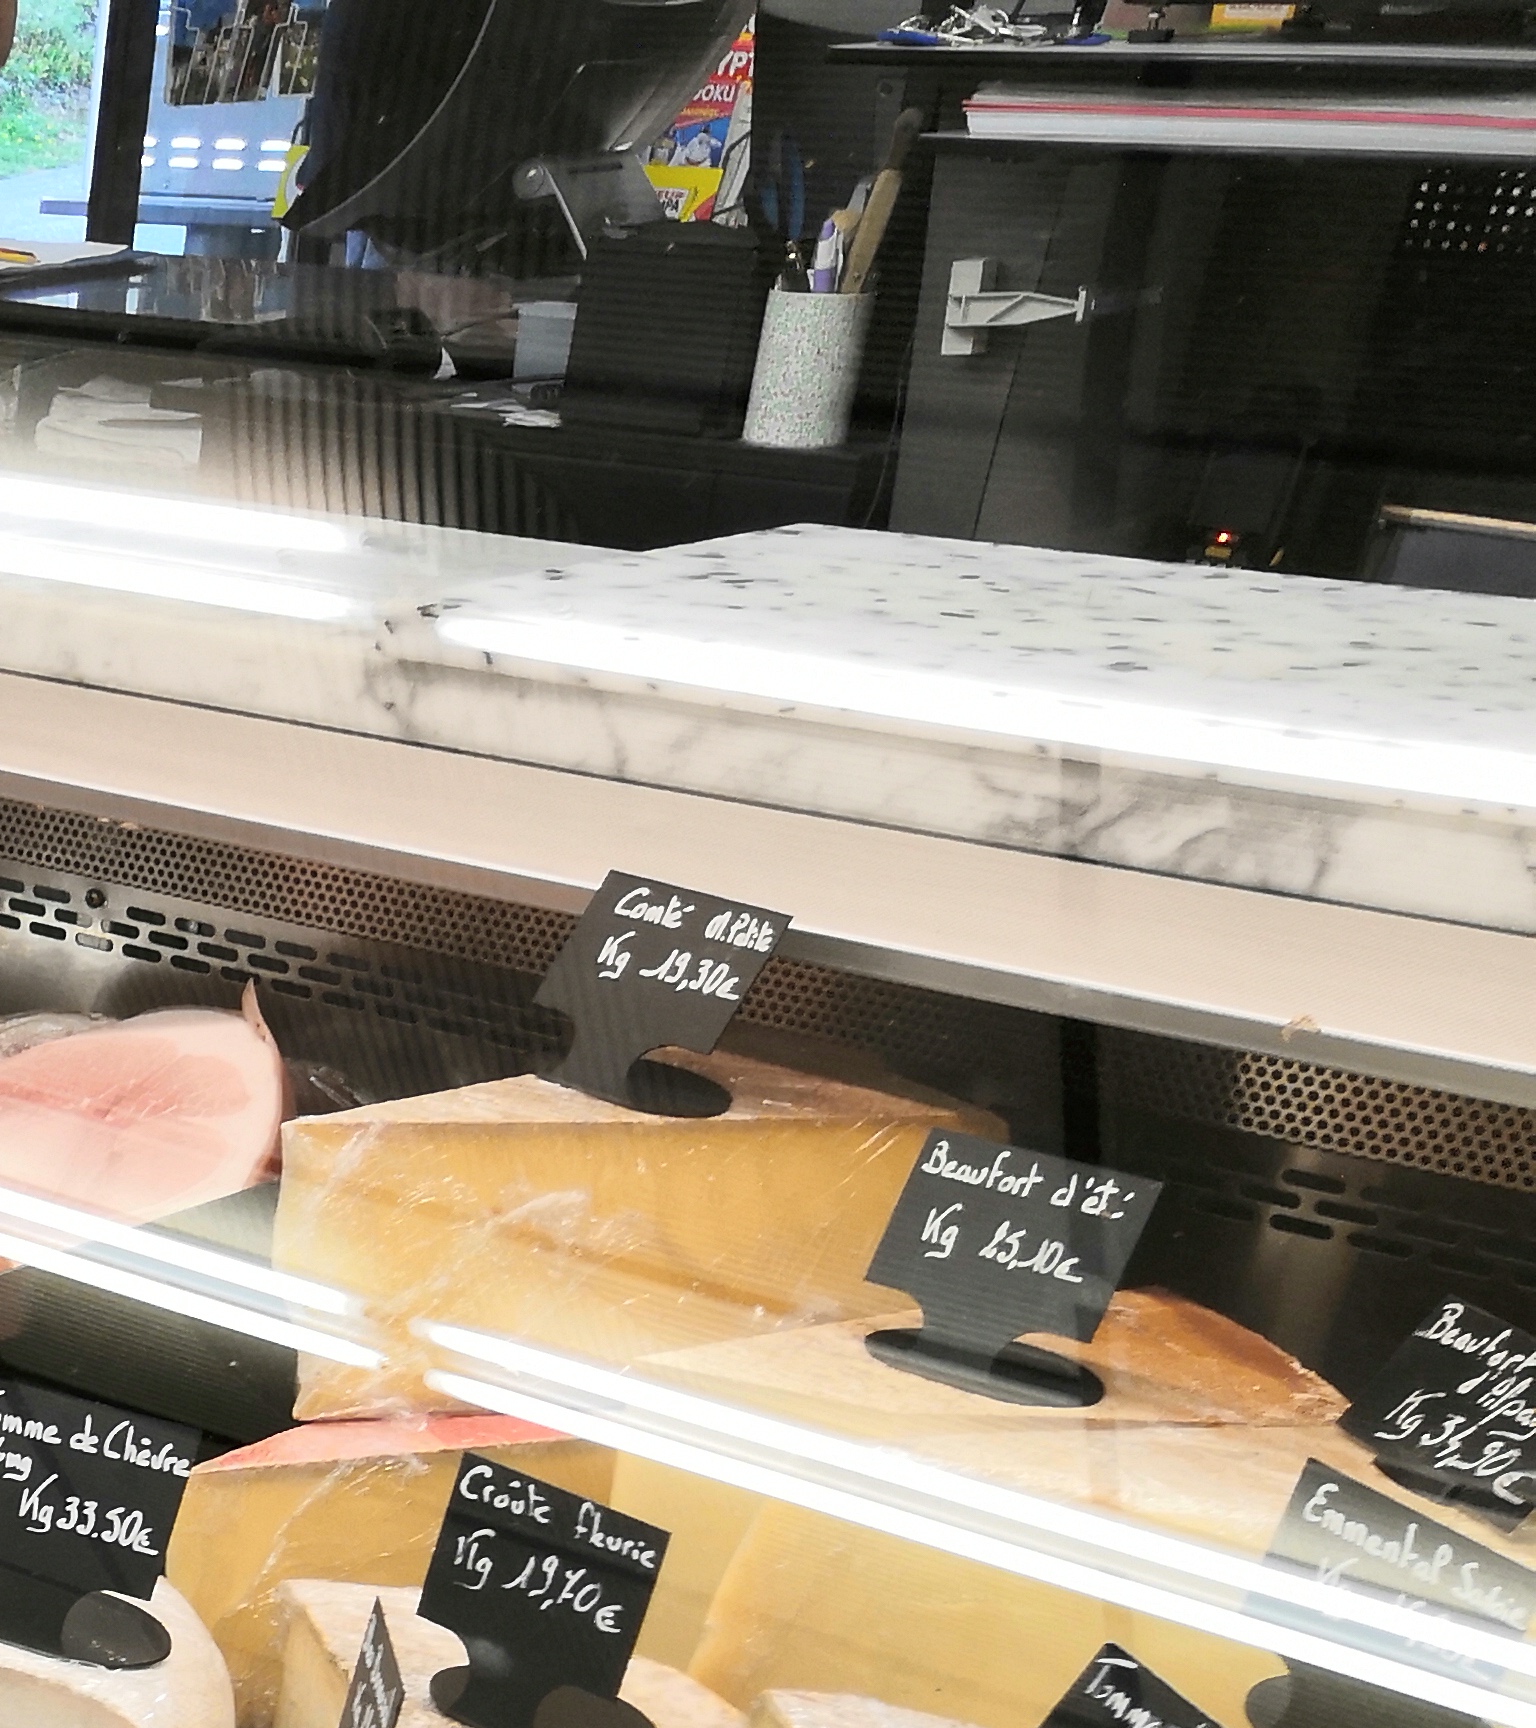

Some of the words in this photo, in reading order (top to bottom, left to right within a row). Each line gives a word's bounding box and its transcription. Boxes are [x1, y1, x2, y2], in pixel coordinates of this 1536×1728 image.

[613, 886, 696, 930] Comté
[596, 930, 637, 980] Kg
[638, 948, 741, 1001] 19,30€
[920, 1139, 1045, 1199] Beaufort
[920, 1202, 964, 1259] Kg
[69, 1413, 100, 1454] de
[1374, 1388, 1447, 1442] Kg
[18, 1473, 59, 1534] Kg
[453, 1528, 497, 1591] Kg
